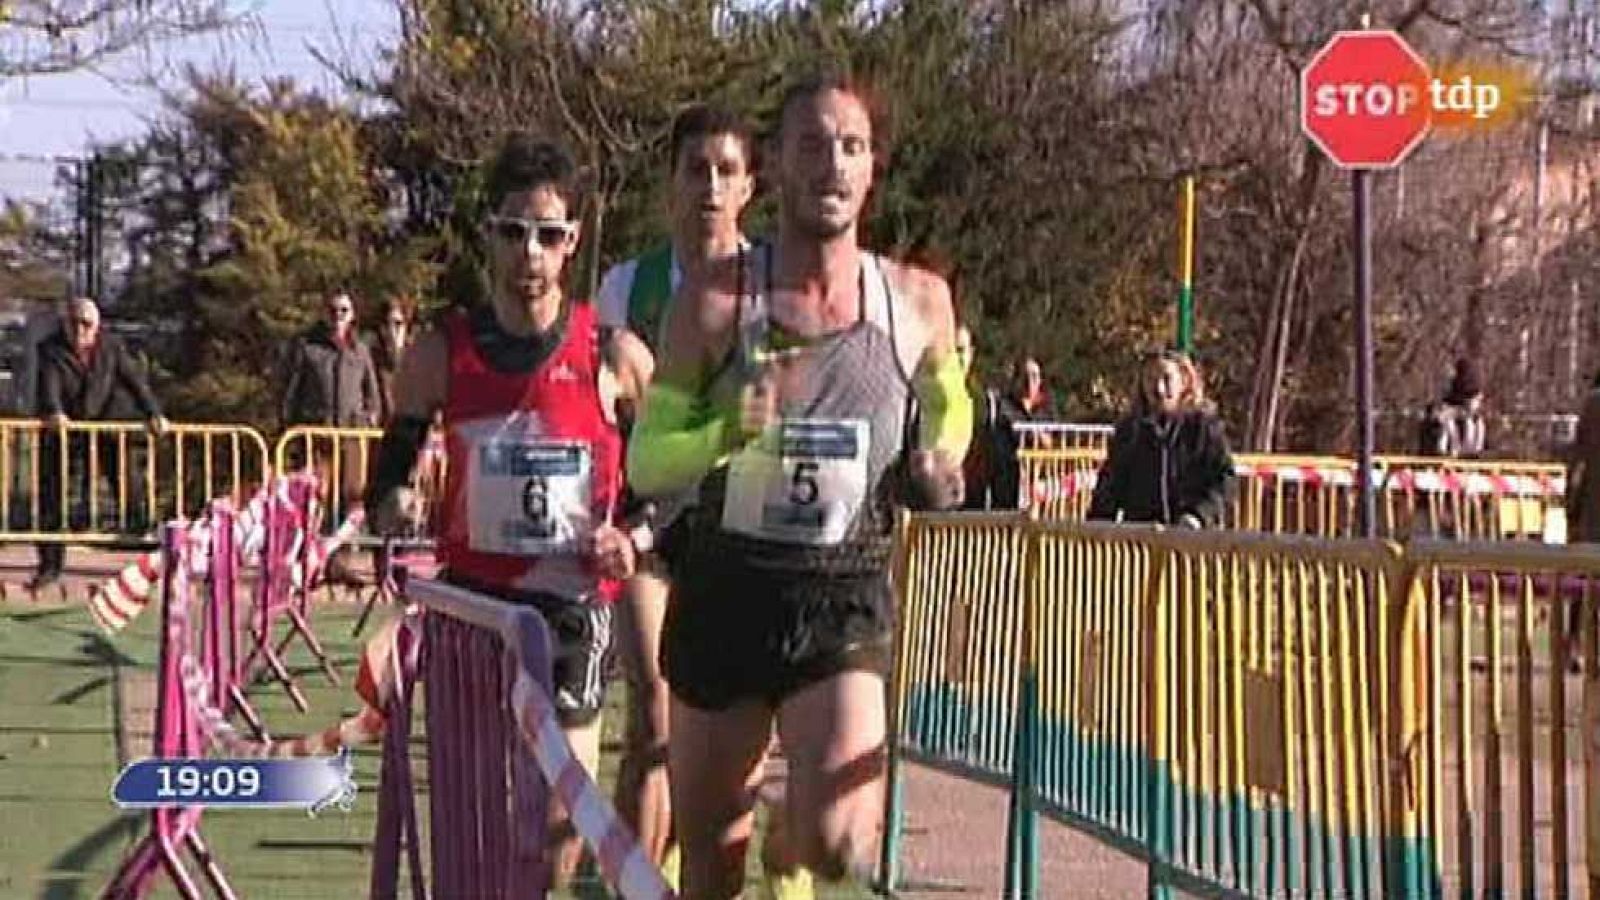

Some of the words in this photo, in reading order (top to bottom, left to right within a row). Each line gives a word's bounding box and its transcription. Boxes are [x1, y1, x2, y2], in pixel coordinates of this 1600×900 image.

[1315, 83, 1419, 116] STOP
[523, 476, 548, 521] 6
[791, 463, 818, 505] 5
